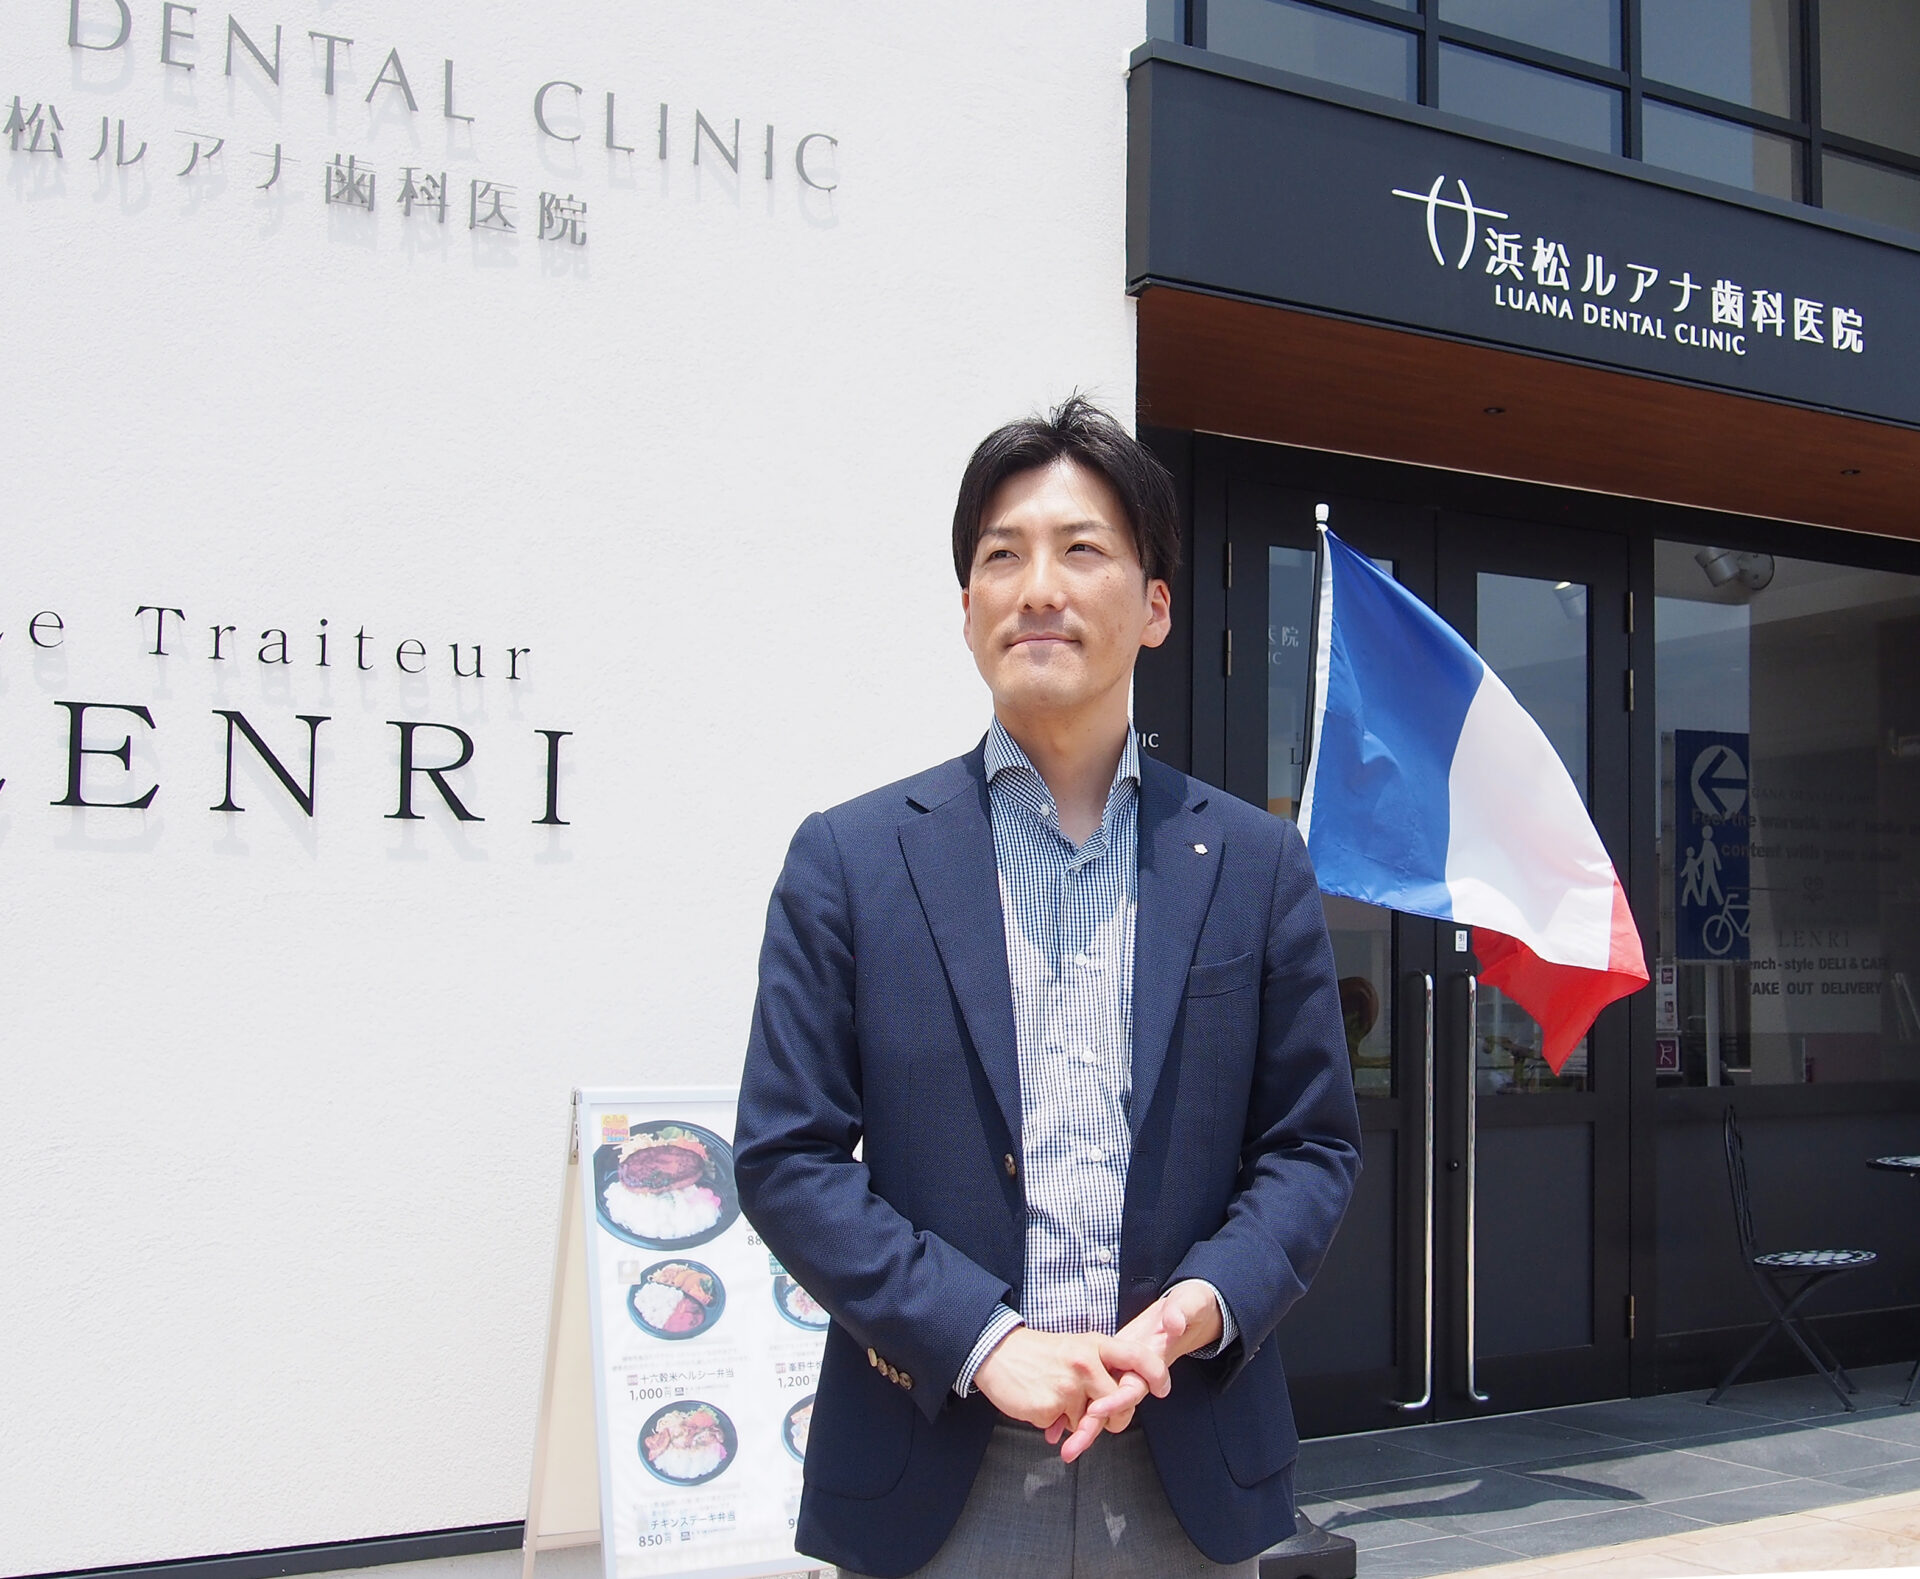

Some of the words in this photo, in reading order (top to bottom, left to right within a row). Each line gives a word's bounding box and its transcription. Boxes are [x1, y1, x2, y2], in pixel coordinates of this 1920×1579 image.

[68, 0, 476, 124] DENTAL
[533, 80, 839, 191] CLINIC
[2, 95, 588, 246] 松ルアナ歯科医院
[1484, 227, 1864, 354] 浜松ルアナ歯科医院
[1495, 284, 1573, 321] LUANA
[1583, 302, 1667, 340] DENTAL
[1674, 323, 1747, 356] CLINIC
[134, 605, 531, 680] Traiteur
[0, 700, 574, 826] ENRI
[1778, 930, 1850, 949] LENRI
[1818, 957, 1847, 970] DELI
[1786, 982, 1815, 995] OUT
[1821, 982, 1883, 995] DELIVERY
[629, 1387, 663, 1401] 1,000
[777, 1375, 810, 1389] 1,200
[638, 1533, 664, 1548] 850
